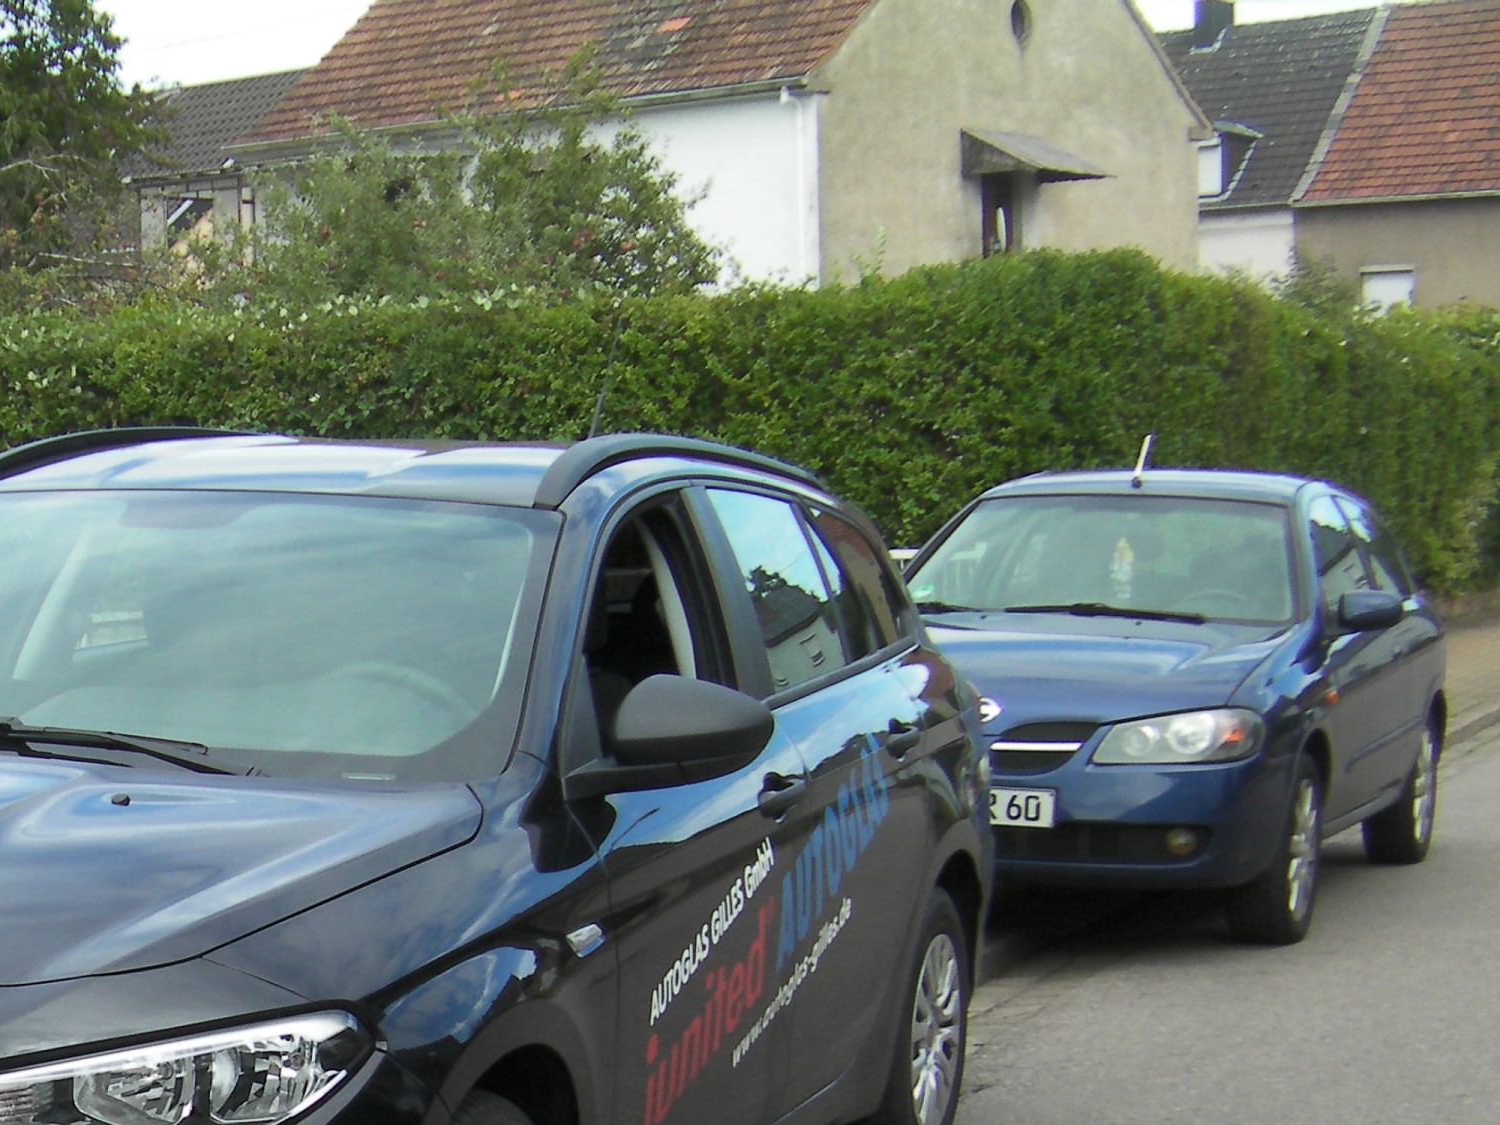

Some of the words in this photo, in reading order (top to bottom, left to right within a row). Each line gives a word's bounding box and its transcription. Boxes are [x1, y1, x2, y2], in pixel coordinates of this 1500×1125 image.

[1006, 794, 1041, 822] 60
[650, 923, 710, 1027] AUTOGLAS
[710, 878, 744, 945] GILLES
[744, 836, 775, 899] GmbH
